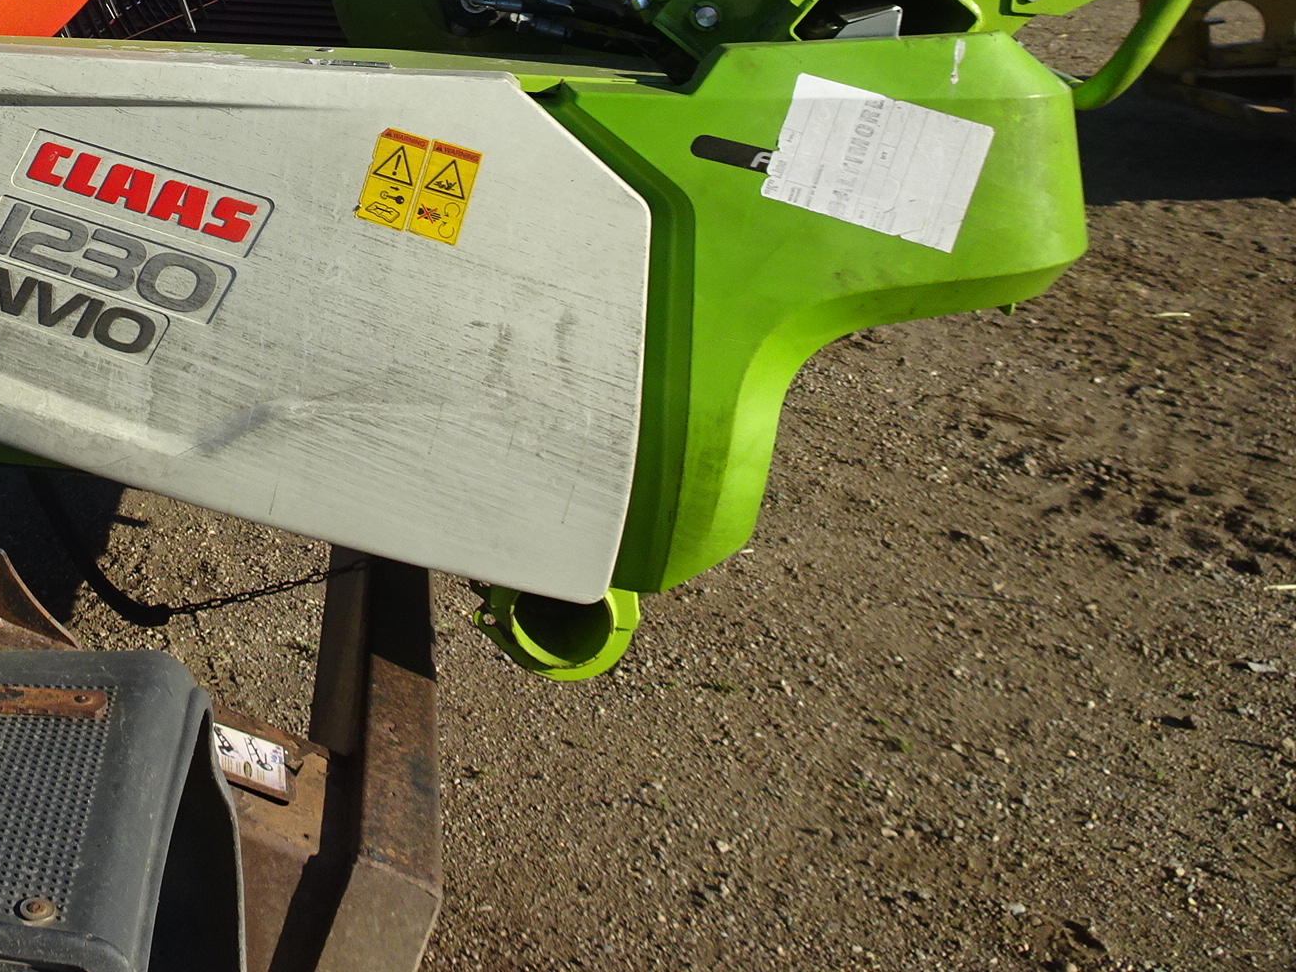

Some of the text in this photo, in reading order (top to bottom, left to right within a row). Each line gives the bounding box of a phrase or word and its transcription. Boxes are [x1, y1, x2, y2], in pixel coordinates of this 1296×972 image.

[393, 132, 426, 148] WARNING
[443, 146, 480, 162] WARNING
[26, 141, 258, 243] CLAAS
